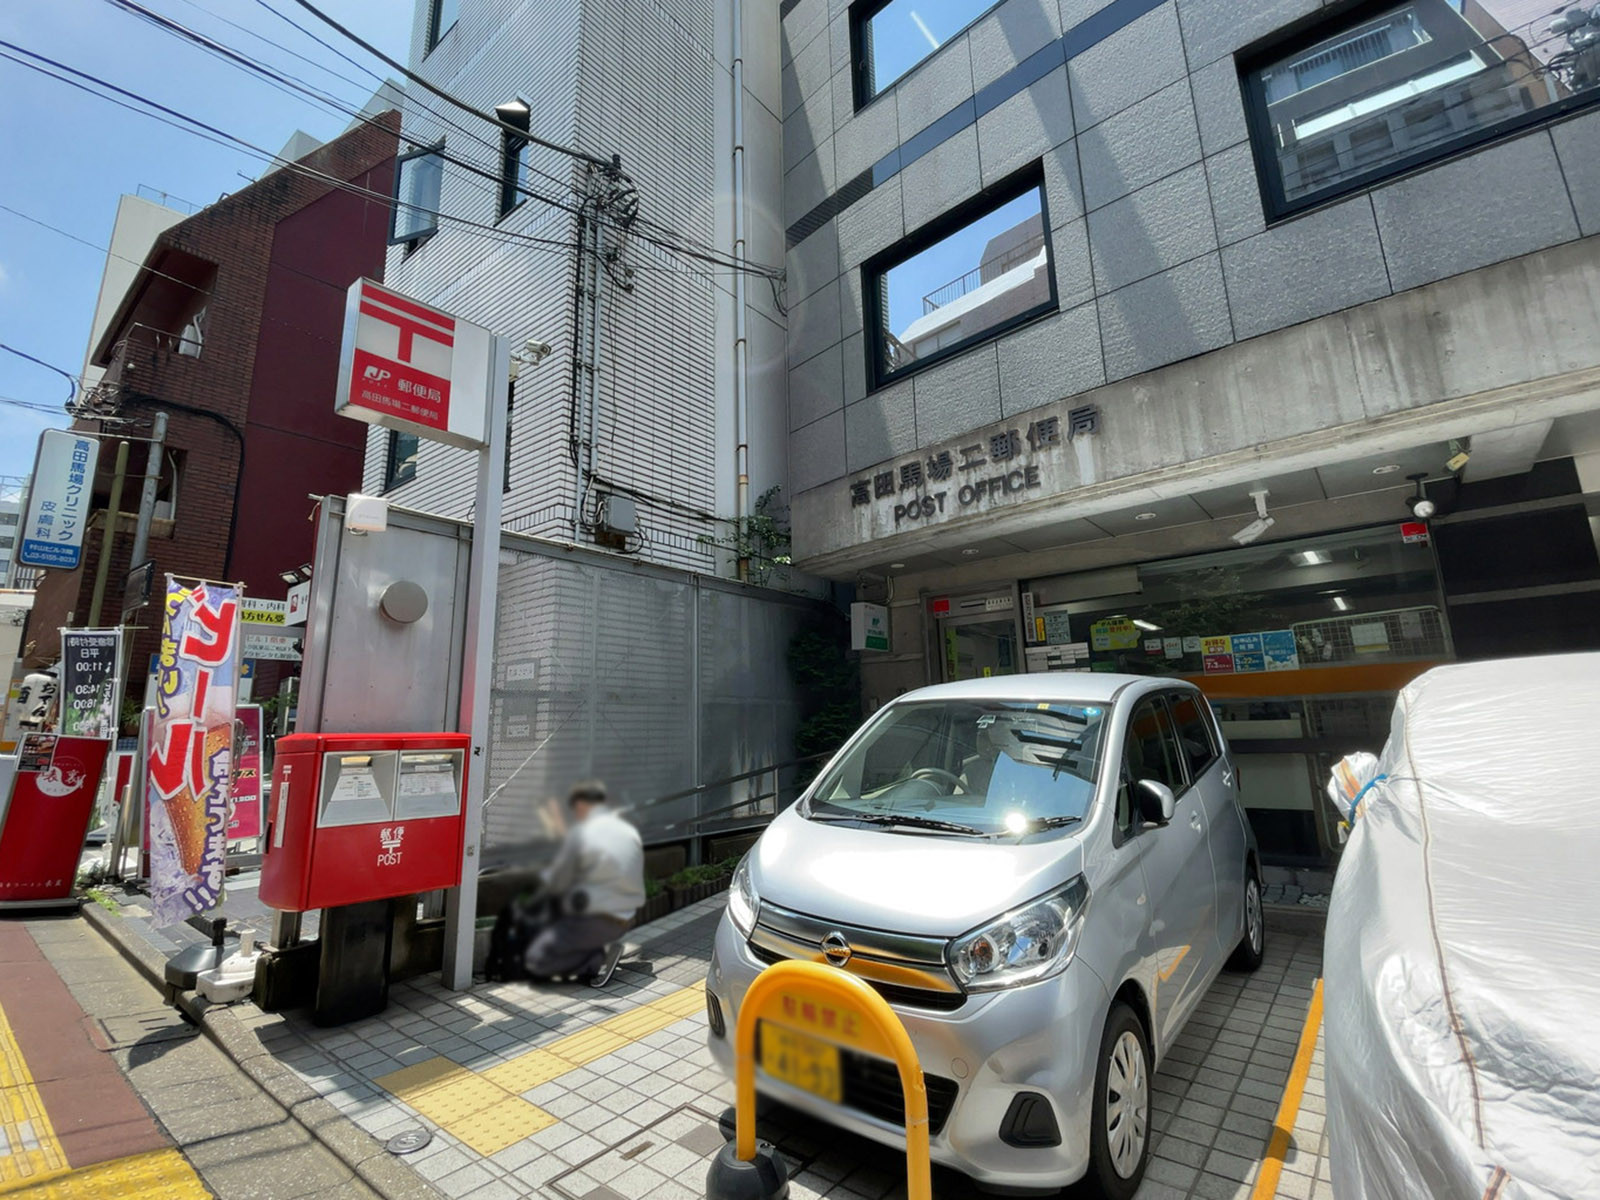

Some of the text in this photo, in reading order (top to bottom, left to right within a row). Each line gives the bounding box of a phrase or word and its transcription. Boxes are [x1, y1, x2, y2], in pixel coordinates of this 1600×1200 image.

[398, 379, 441, 403] 郵便局
[850, 404, 1099, 508] 高田馬場二郵便局
[58, 440, 90, 541] 高田馬場クリニック
[894, 465, 1041, 521] POST OFFICE
[35, 501, 56, 539] 皮膚科
[380, 826, 405, 842] 郵便
[377, 852, 403, 867] POST
